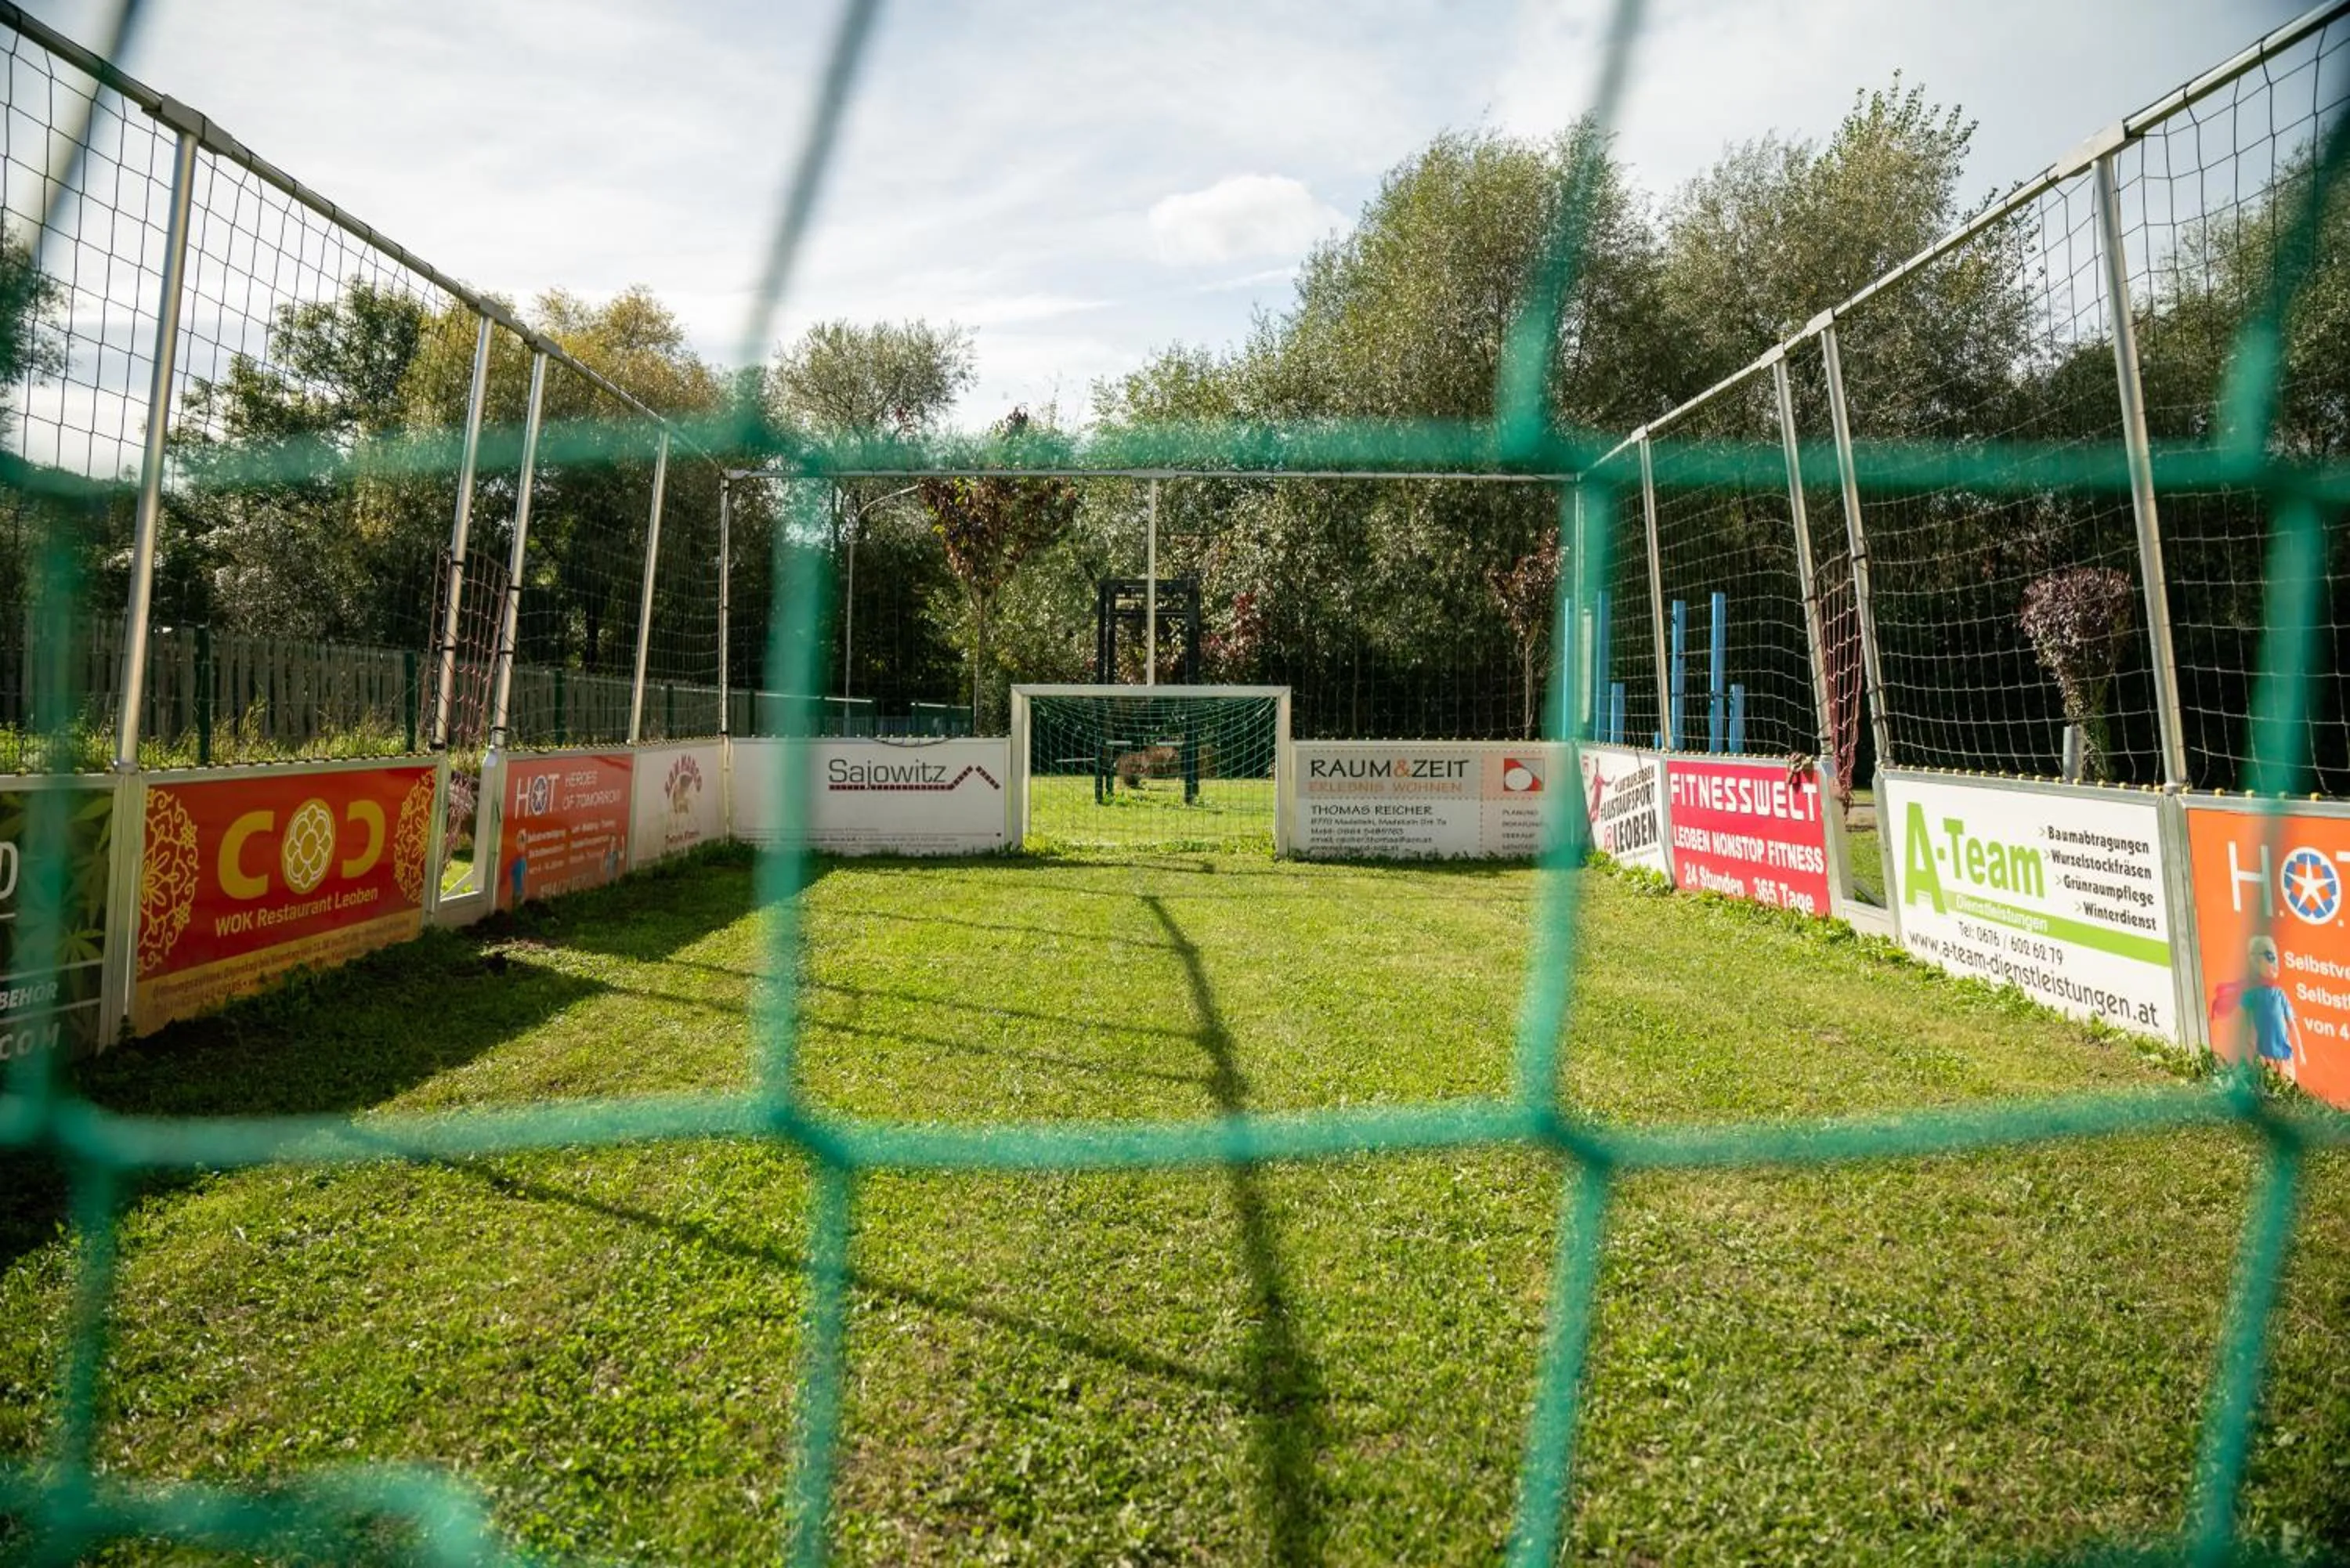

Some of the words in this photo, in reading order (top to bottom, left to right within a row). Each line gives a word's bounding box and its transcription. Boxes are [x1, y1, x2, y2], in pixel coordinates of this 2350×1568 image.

[828, 758, 947, 789] Sajowitz
[1310, 758, 1470, 778] RAUM&ZEIT
[1392, 782, 1462, 793] WOHNEN
[1669, 772, 1817, 821] FITNESSWELT
[1311, 804, 1370, 815] THOMAS
[1375, 804, 1433, 815] REICHER
[1672, 824, 1711, 854] LEOBEN
[1712, 829, 1765, 862] NONSTOP
[1767, 840, 1824, 874] FITNESS
[2048, 826, 2149, 854] Baumabtragungen
[1904, 801, 2045, 915] A-Team
[2051, 849, 2153, 880] Wurzelstockfräsen
[1684, 861, 1697, 886] 24
[1699, 865, 1744, 898] Stunden
[1753, 876, 1778, 903] 365
[1779, 882, 1815, 915] Tage
[2063, 875, 2154, 905] Grünraumpflege
[215, 911, 253, 938] WOK
[257, 896, 332, 927] Restaurant
[334, 887, 379, 910] Leoben
[1956, 893, 2048, 933] Dienstleistungen
[2084, 901, 2157, 930] Winterdienst
[1958, 920, 1974, 938] Tel:
[1976, 927, 2000, 947] 0676
[2011, 936, 2030, 956] 602
[2033, 942, 2046, 961] 62
[2049, 947, 2063, 965] 79
[1909, 930, 2160, 1028] www.a-team-dienstleistungen.at
[2296, 982, 2350, 1010] Selbst
[2303, 1017, 2335, 1037] von
